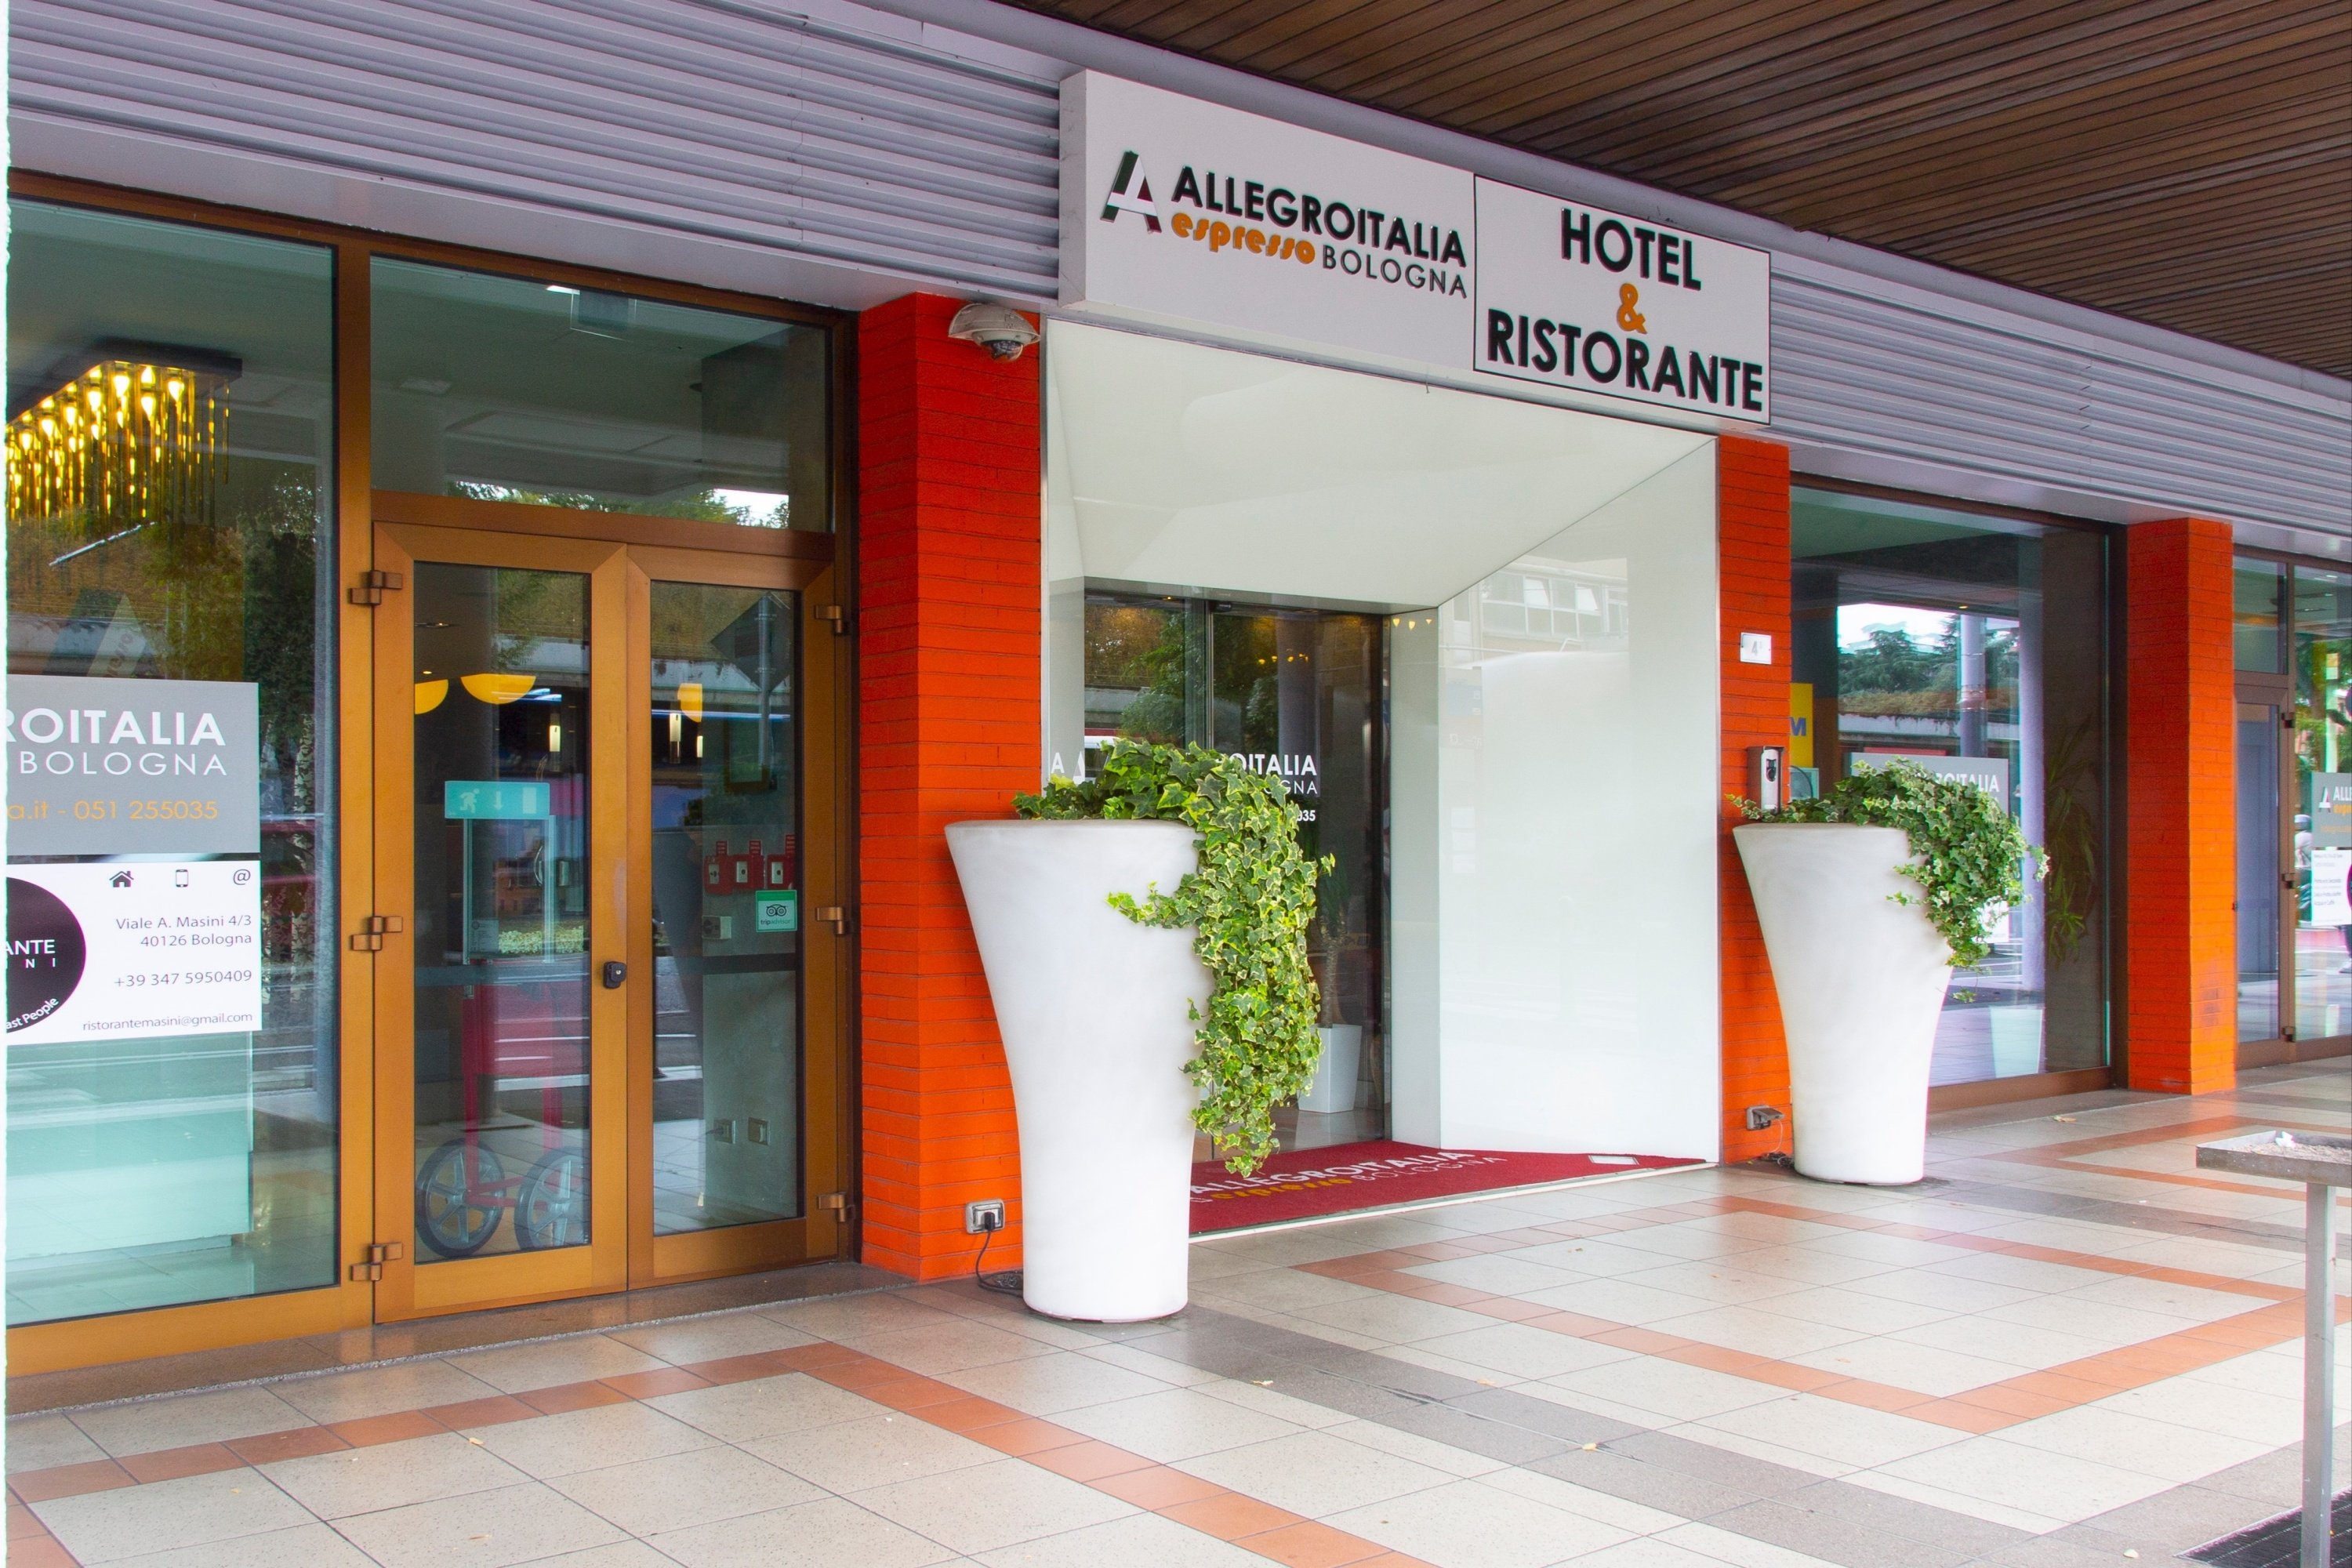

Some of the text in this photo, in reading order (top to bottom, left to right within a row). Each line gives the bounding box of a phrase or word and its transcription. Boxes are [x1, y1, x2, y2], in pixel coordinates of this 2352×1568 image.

[1171, 165, 1467, 268] ALLEGROITALIA
[1171, 212, 1468, 299] espresso BOLOGNA
[1561, 208, 1701, 291] HOTEL
[1617, 283, 1647, 334] &
[1487, 308, 1762, 412] RISTORANTE
[20, 750, 227, 775] BOLOGNA
[74, 800, 117, 820] 051
[129, 800, 219, 820] 255035
[116, 914, 252, 930] Viale A. Masini 4/3
[140, 933, 252, 947] 40126 Bologna
[114, 970, 252, 988] +39 347 5950409
[21, 997, 60, 1024] People
[83, 1012, 253, 1031] ristorantemasini@gmail.com
